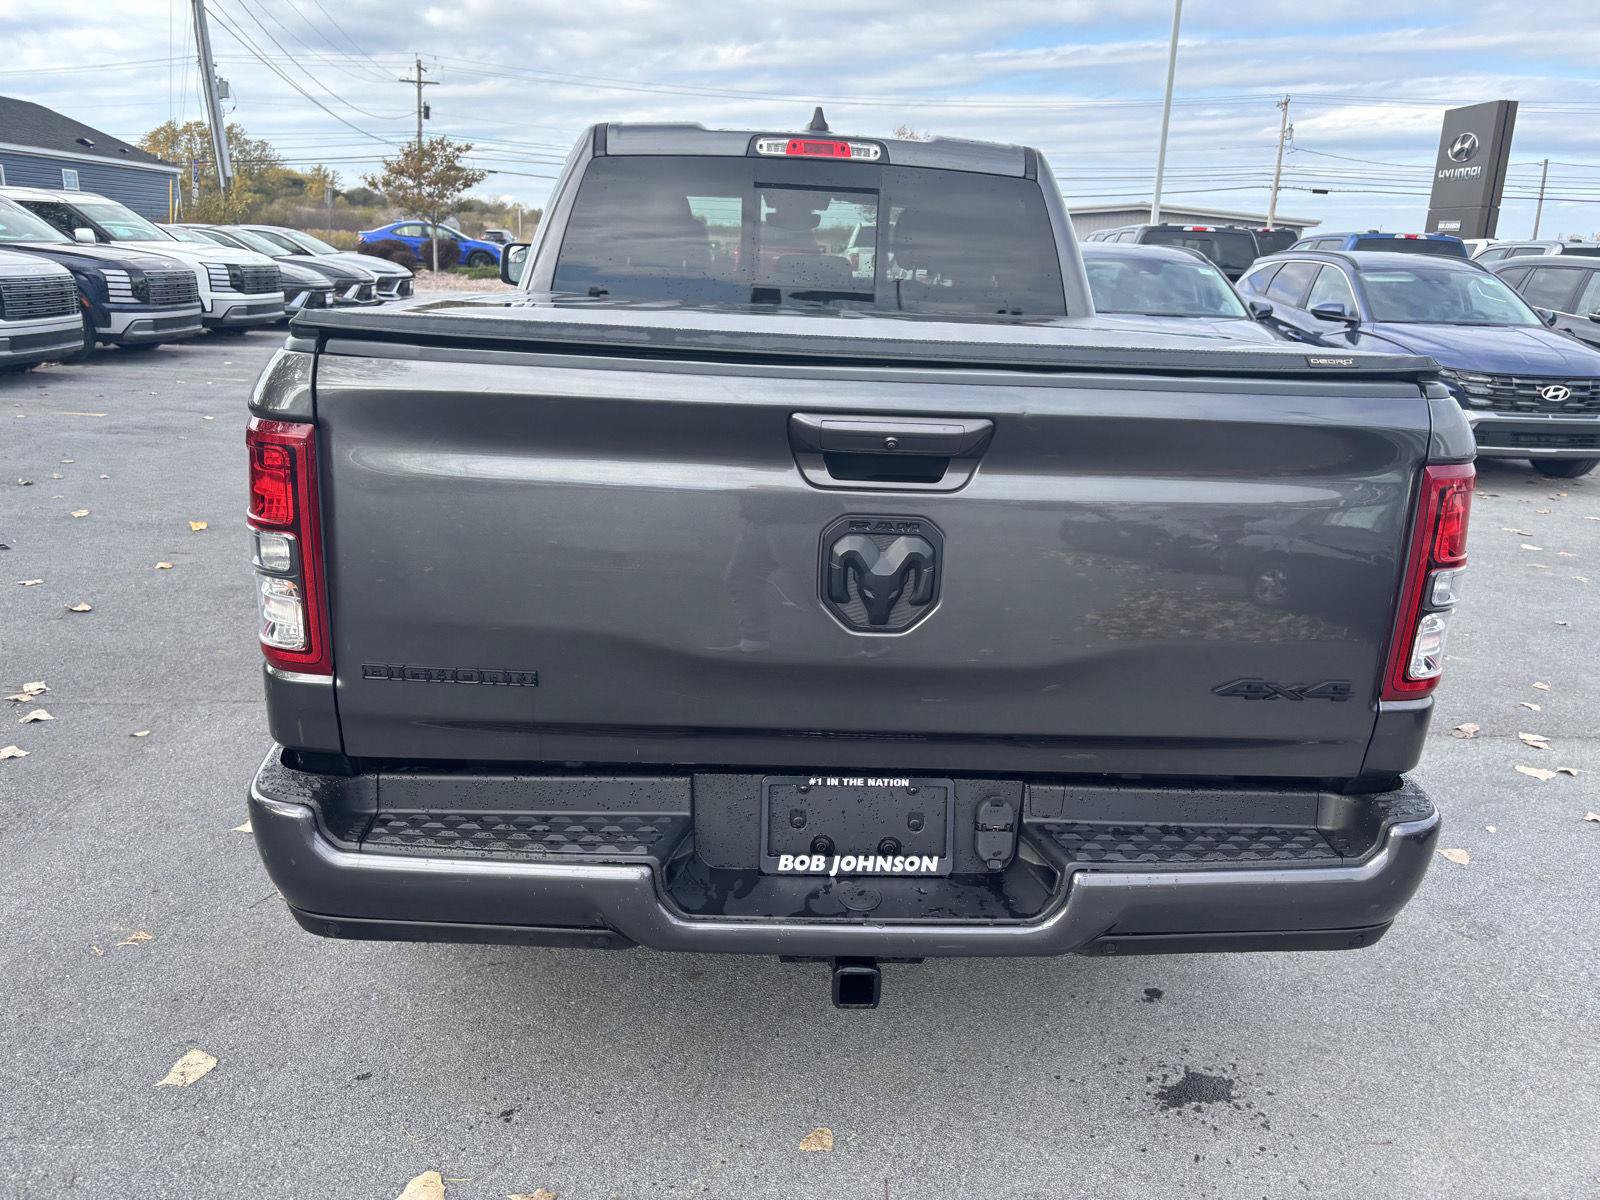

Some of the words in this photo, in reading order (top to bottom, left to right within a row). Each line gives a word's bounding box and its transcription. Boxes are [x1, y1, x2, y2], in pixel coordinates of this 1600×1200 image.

[808, 777, 822, 786] #1
[826, 778, 839, 786] IN
[842, 778, 864, 786] THE
[867, 778, 910, 787] NATION
[777, 854, 826, 871] BOB
[828, 855, 939, 877] JOHNSON
